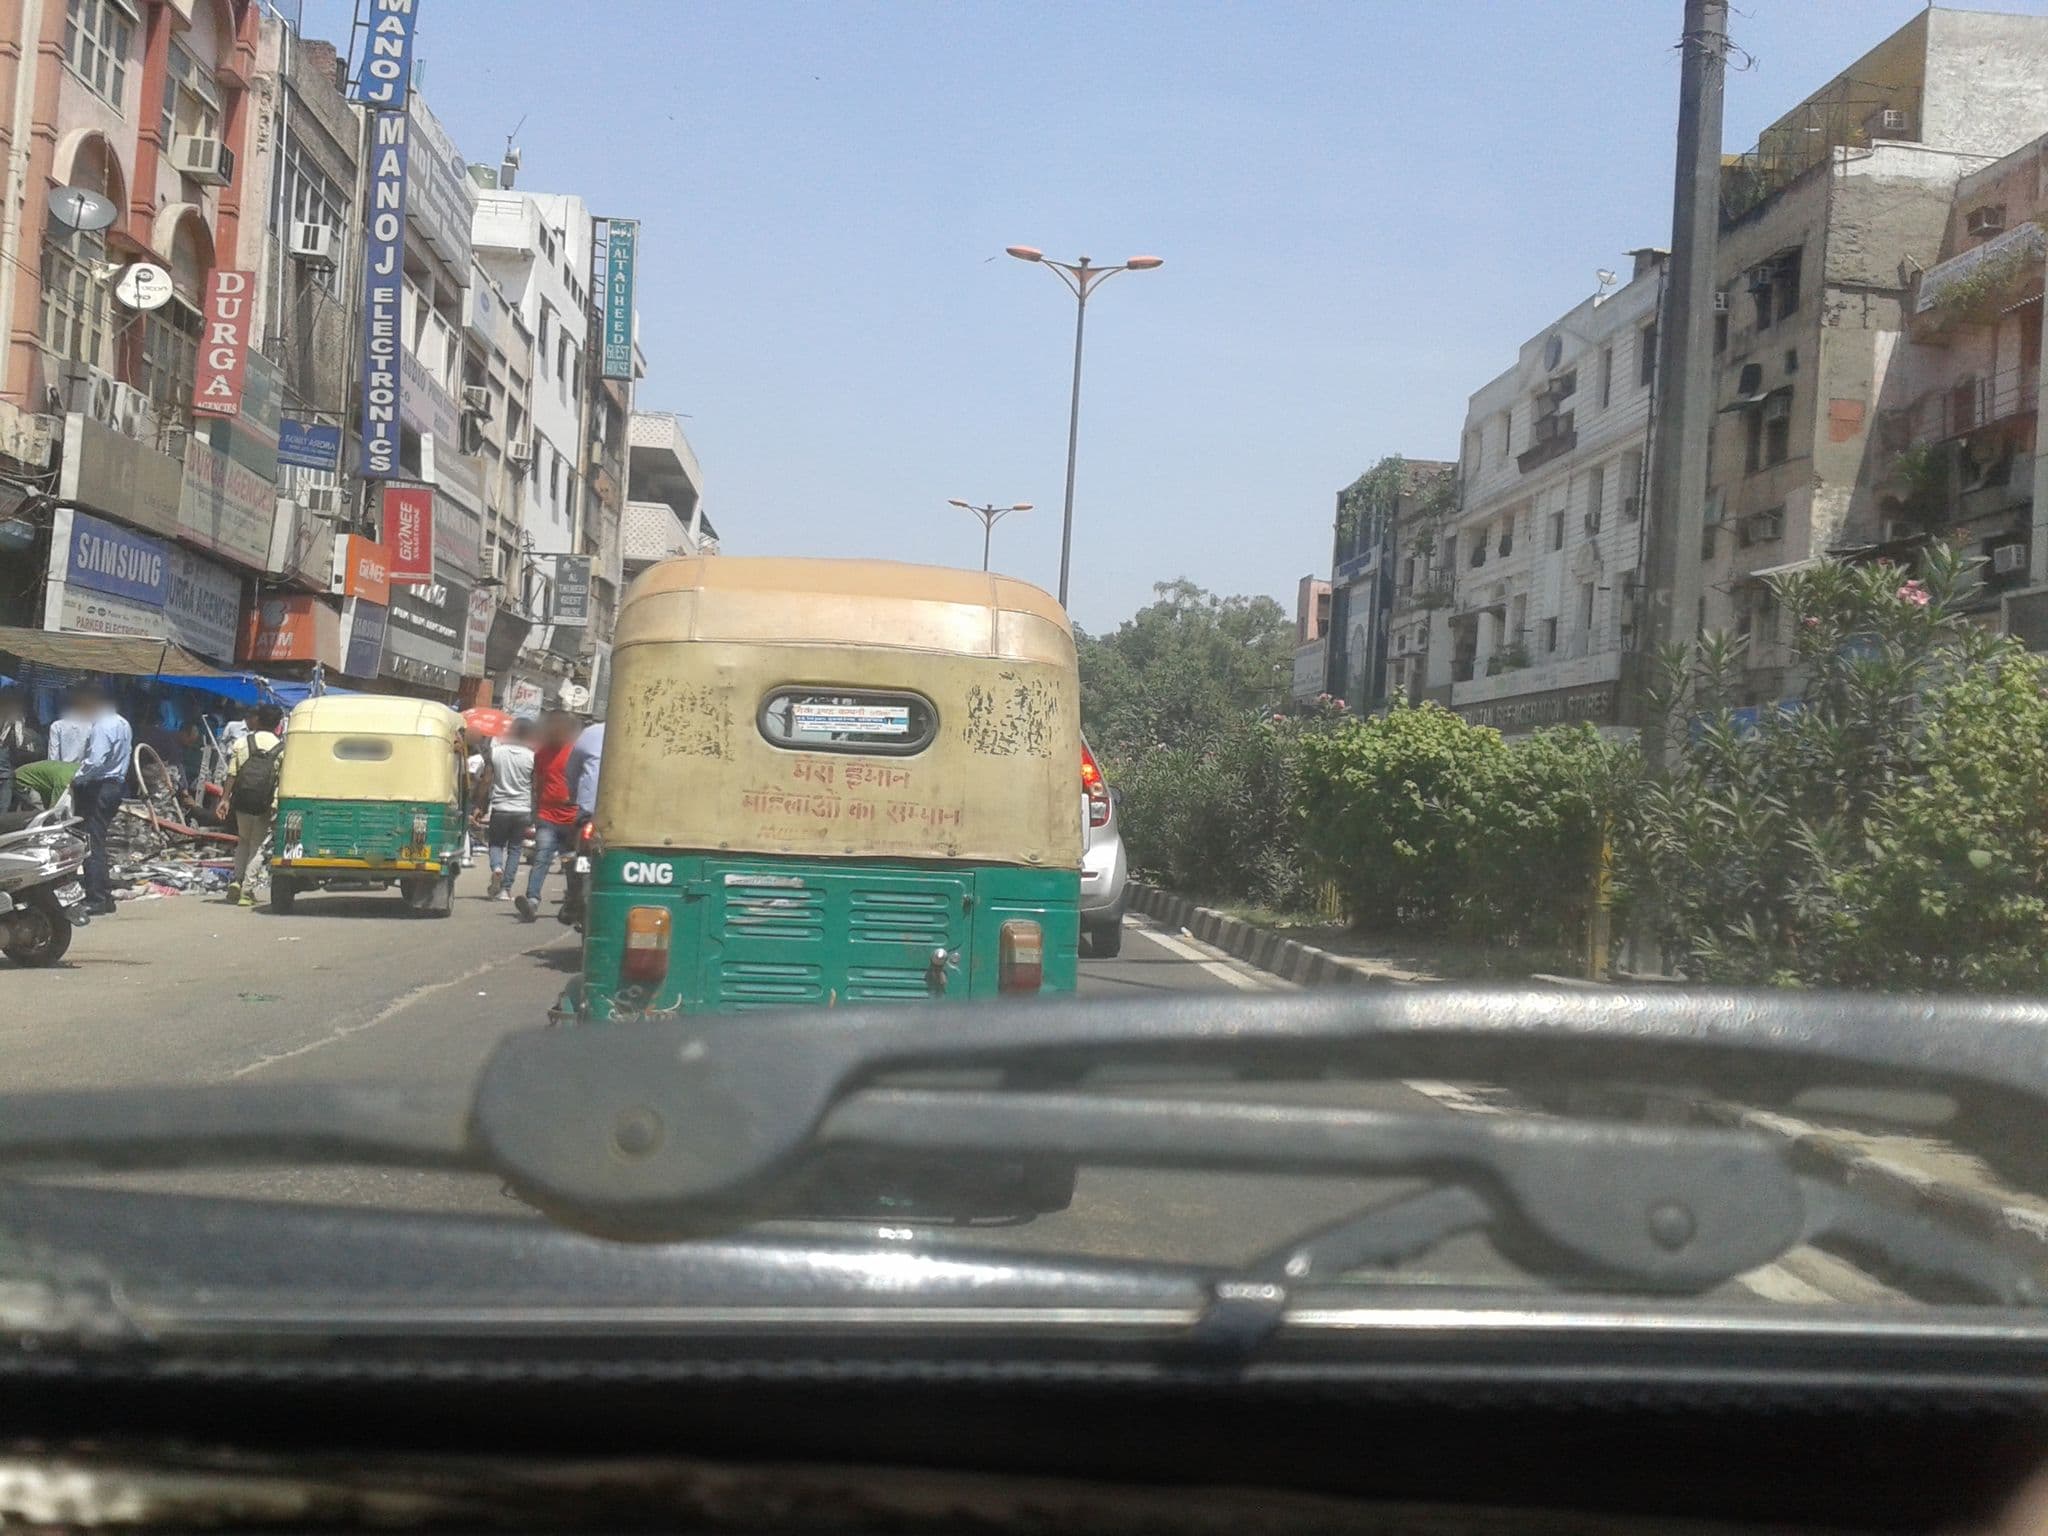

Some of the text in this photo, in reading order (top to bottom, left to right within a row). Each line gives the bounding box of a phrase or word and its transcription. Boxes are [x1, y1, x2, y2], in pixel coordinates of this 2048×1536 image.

[368, 0, 412, 101] MANOJ
[613, 248, 629, 259] AL
[368, 116, 405, 472] MANOJ ELECTRONICS
[614, 260, 627, 344] TAUHEED
[204, 272, 245, 396] DURGA
[196, 402, 237, 413] AGENCIES
[76, 532, 162, 587] SAMSUNG
[76, 615, 104, 633] PARKER
[257, 631, 294, 647] ATM
[622, 861, 673, 885] CNG
